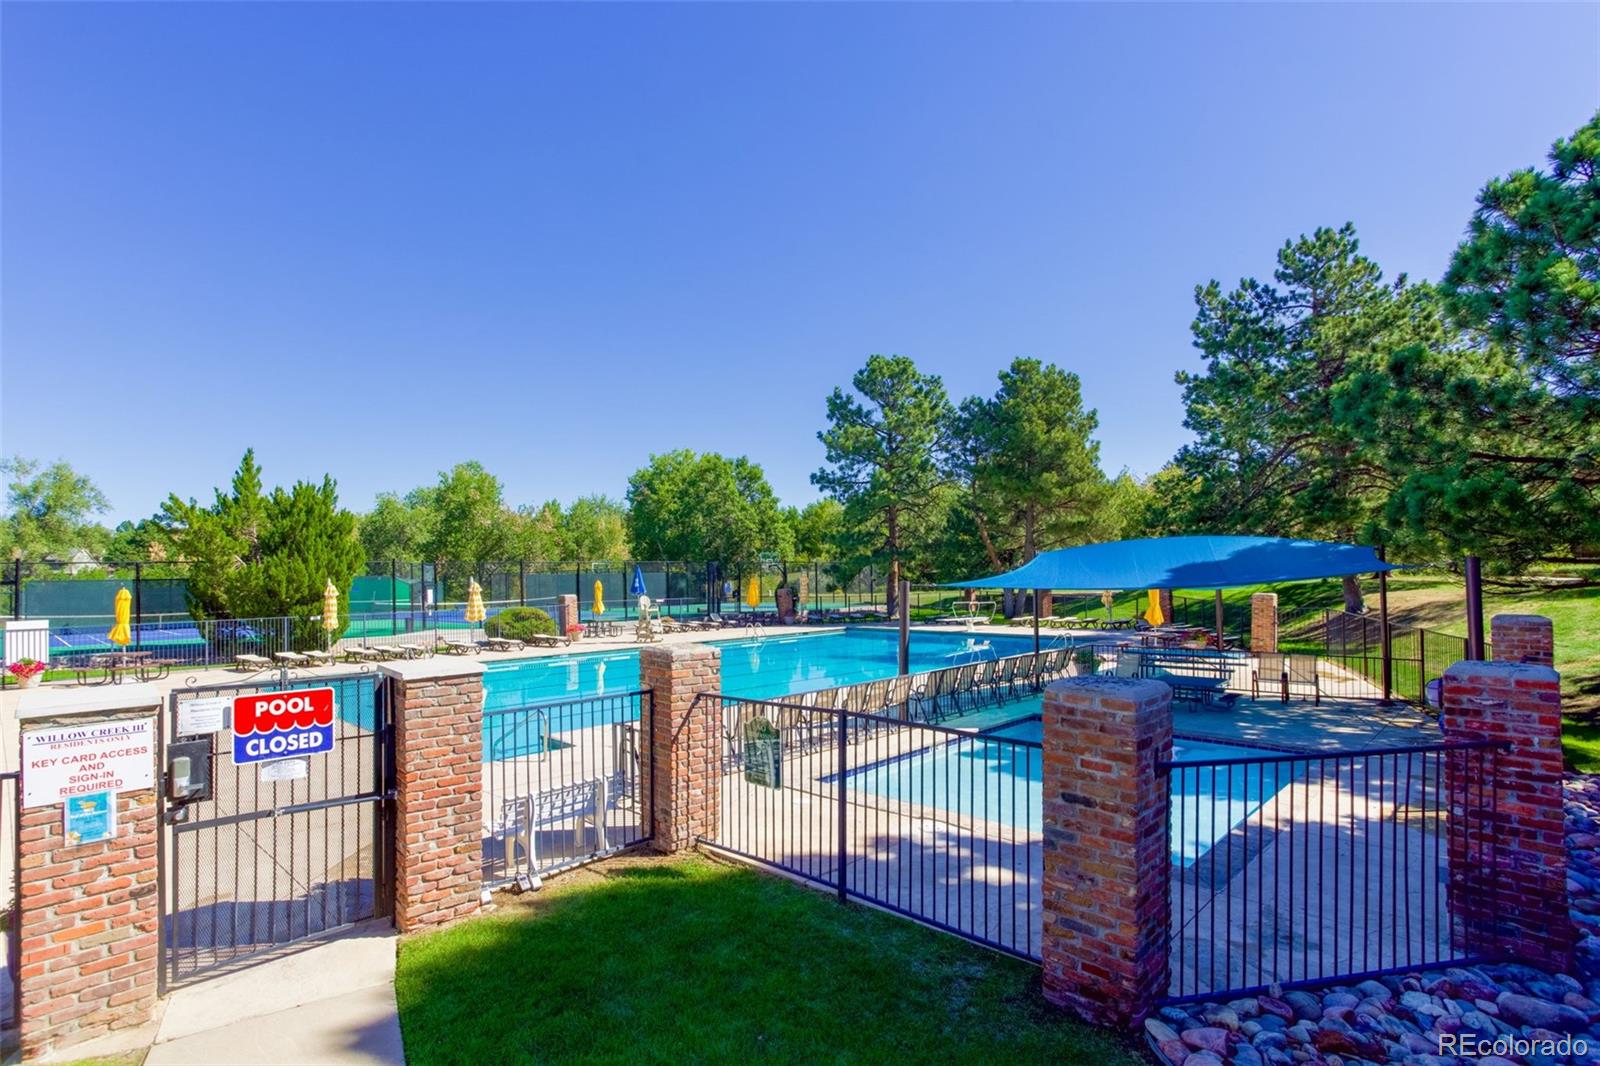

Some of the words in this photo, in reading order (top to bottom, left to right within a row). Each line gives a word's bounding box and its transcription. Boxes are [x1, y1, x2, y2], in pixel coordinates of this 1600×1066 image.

[255, 696, 314, 717] POOL
[36, 731, 86, 743] WILLOW
[91, 726, 129, 737] CREEK
[132, 724, 145, 732] III
[245, 731, 323, 756] CLOSED
[31, 758, 58, 769] KEY
[61, 753, 97, 765] CARD
[100, 746, 148, 760] ACCESS
[79, 762, 105, 772] AND
[68, 770, 114, 784] SIGN-IN
[59, 779, 123, 795] REQUIRED
